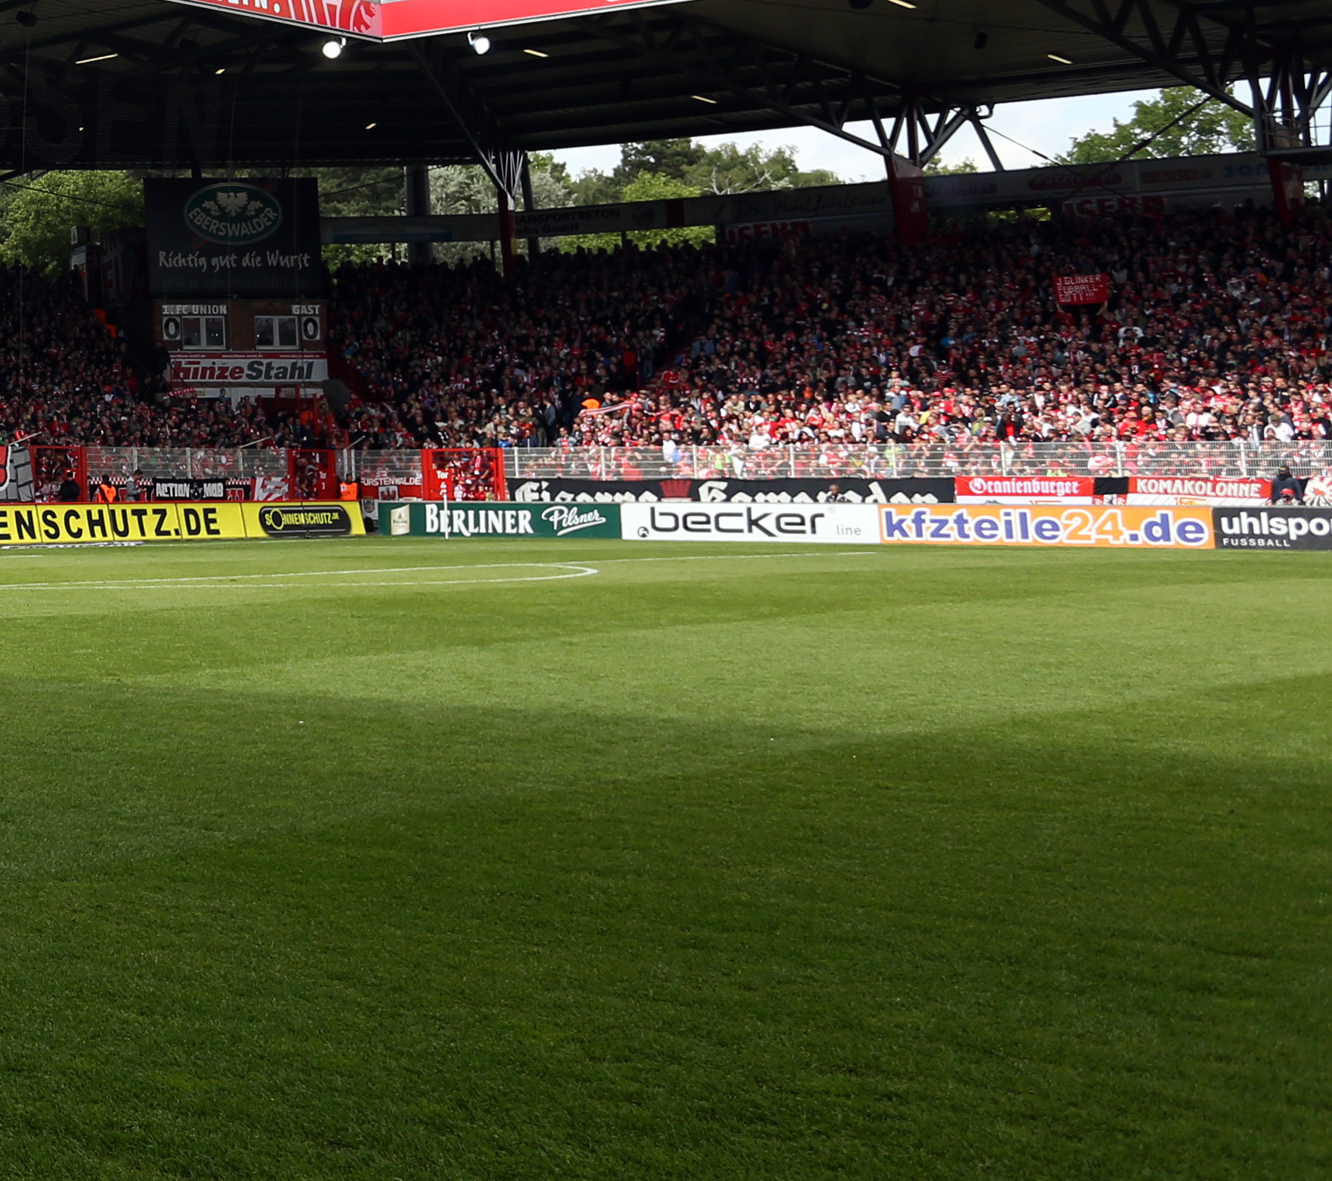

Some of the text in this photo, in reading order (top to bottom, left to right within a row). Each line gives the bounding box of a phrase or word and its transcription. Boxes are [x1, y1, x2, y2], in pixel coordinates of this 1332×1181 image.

[188, 206, 279, 237] EBERSWALDER
[516, 208, 621, 224] ANSPORTBETON
[159, 250, 311, 273] Richtig gut die Wurst
[191, 304, 227, 315] UNION
[292, 304, 320, 315] GAST
[164, 317, 179, 340] 0
[303, 317, 318, 340] 0
[436, 470, 449, 479] Tor
[969, 477, 1079, 495] Oranienburger
[1137, 479, 1262, 498] KOMAKOLONNE
[425, 504, 534, 537] BERLINER
[542, 504, 606, 536] Pilsner
[649, 506, 861, 537] becker line
[884, 506, 1207, 545] kfzteile24.de
[1221, 511, 1332, 540] uhlspo
[1223, 538, 1290, 547] FUSSBALL
